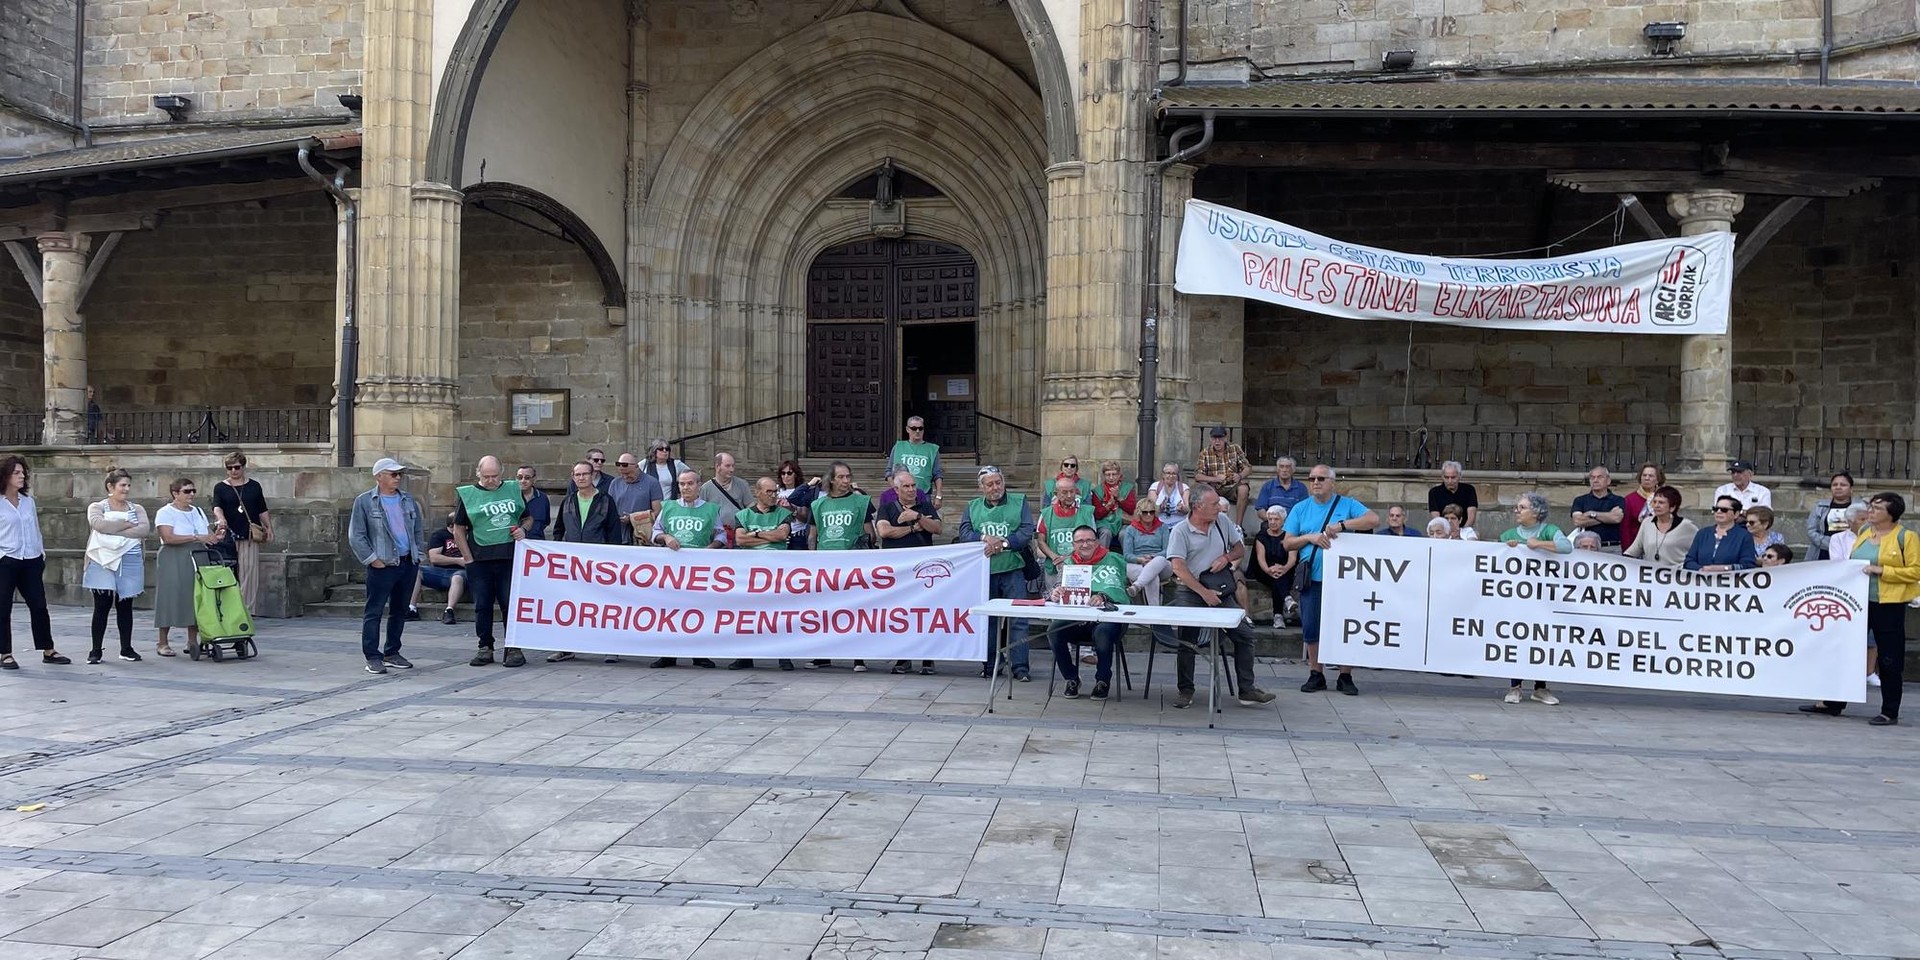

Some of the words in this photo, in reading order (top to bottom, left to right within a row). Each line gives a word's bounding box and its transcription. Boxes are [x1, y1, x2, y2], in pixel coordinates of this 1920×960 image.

[1433, 282, 1641, 324] ELKARTASUNA
[1655, 286, 1677, 322] ARGI
[1676, 265, 1697, 320] GORRIAK
[901, 456, 927, 467] 1080
[481, 501, 516, 516] 1080
[668, 518, 703, 532] 1080
[822, 514, 852, 527] 1080
[1050, 531, 1073, 544] 108
[523, 549, 736, 593] PENSIONES
[747, 566, 896, 594] DIGNAS
[1337, 555, 1411, 583] PNV
[1475, 554, 1627, 582] ELORRIOKO
[1638, 565, 1772, 590] EGUNEKO
[1481, 578, 1652, 608] EGOITZAREN
[1664, 590, 1765, 614] AURKA
[1806, 602, 1840, 614] MPB
[516, 597, 705, 634] ELORRIOKO
[713, 607, 975, 635] PENTSIONISTAK
[1343, 618, 1401, 647] PSE
[1452, 617, 1484, 637] EN
[1495, 620, 1606, 646] CONTRA
[1617, 629, 1667, 650] DEL
[1678, 633, 1794, 658] CENTRO
[1485, 643, 1518, 663] DE
[1529, 646, 1576, 668] DIA
[1587, 651, 1621, 671] DE
[1632, 654, 1756, 680] ELORRIO
